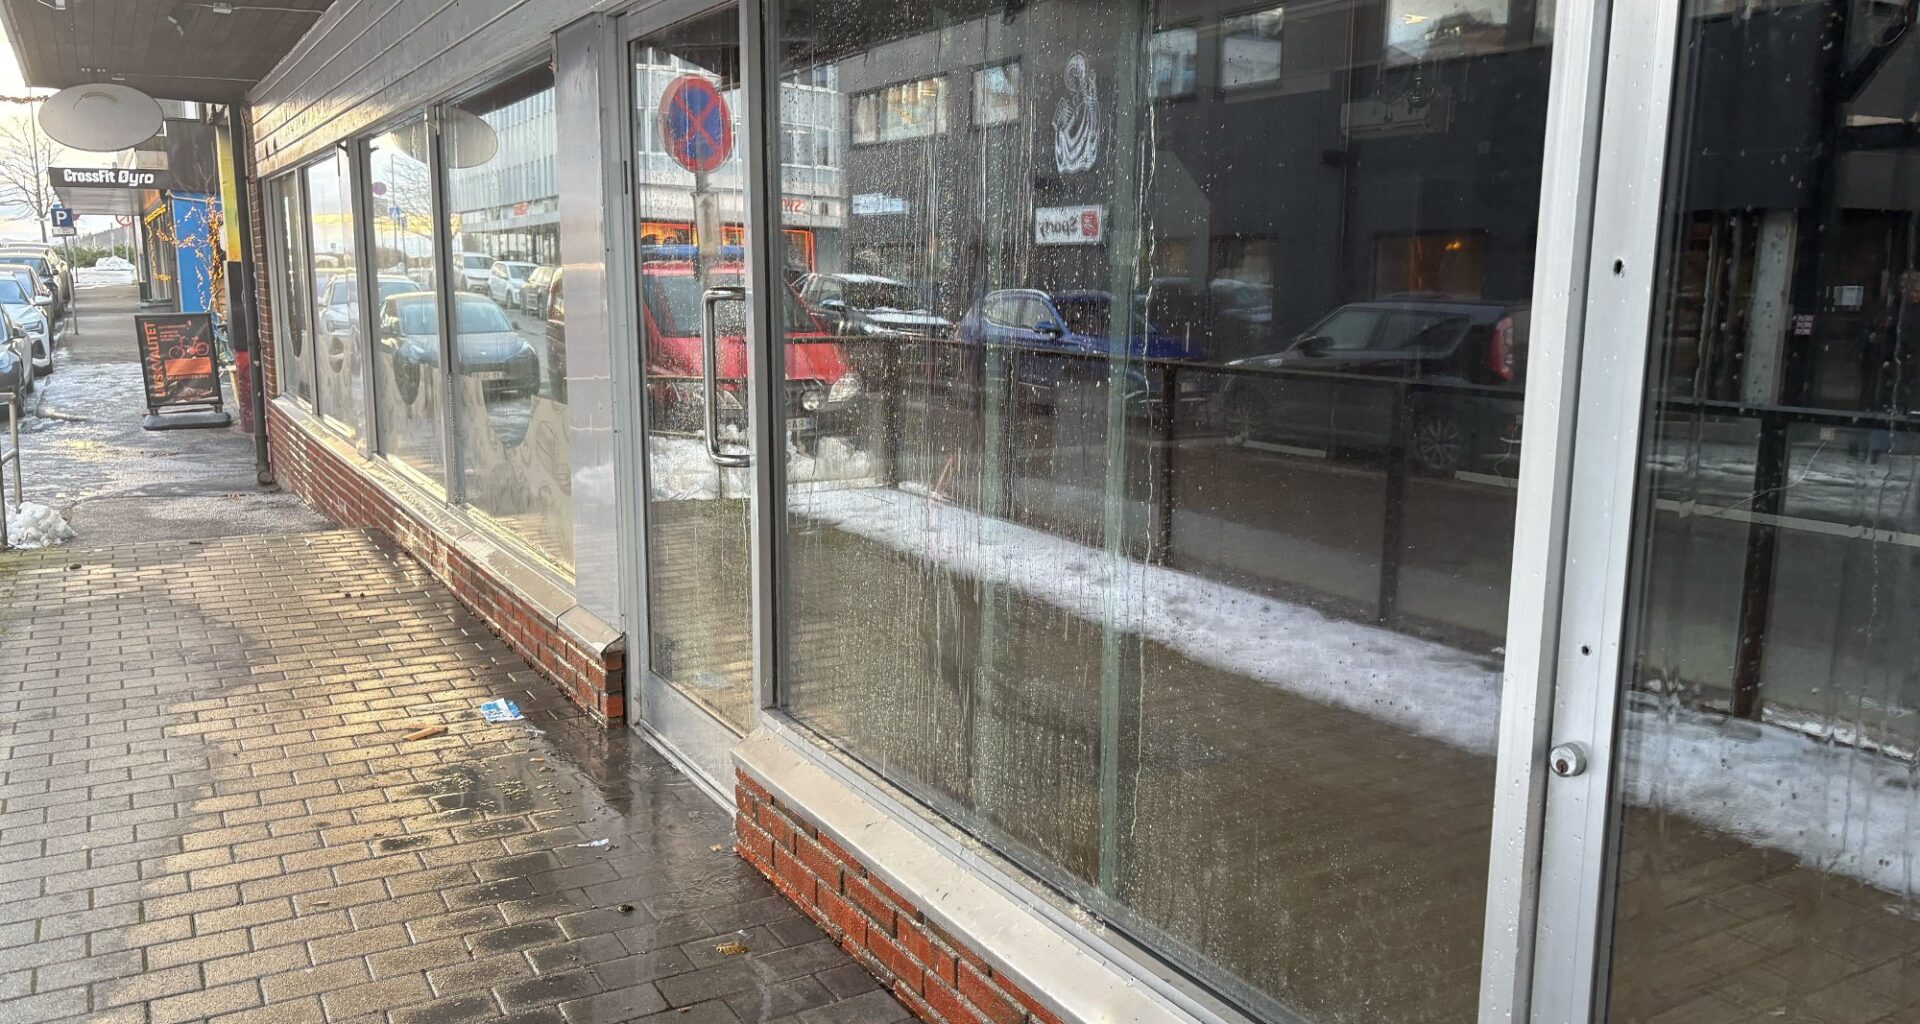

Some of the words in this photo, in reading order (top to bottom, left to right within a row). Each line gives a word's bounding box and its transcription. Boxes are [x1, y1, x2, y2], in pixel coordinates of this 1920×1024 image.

[63, 168, 116, 183] CrossFit
[118, 170, 155, 186] Øyro
[56, 210, 68, 225] P
[144, 322, 165, 398] LIVSKVALITET
